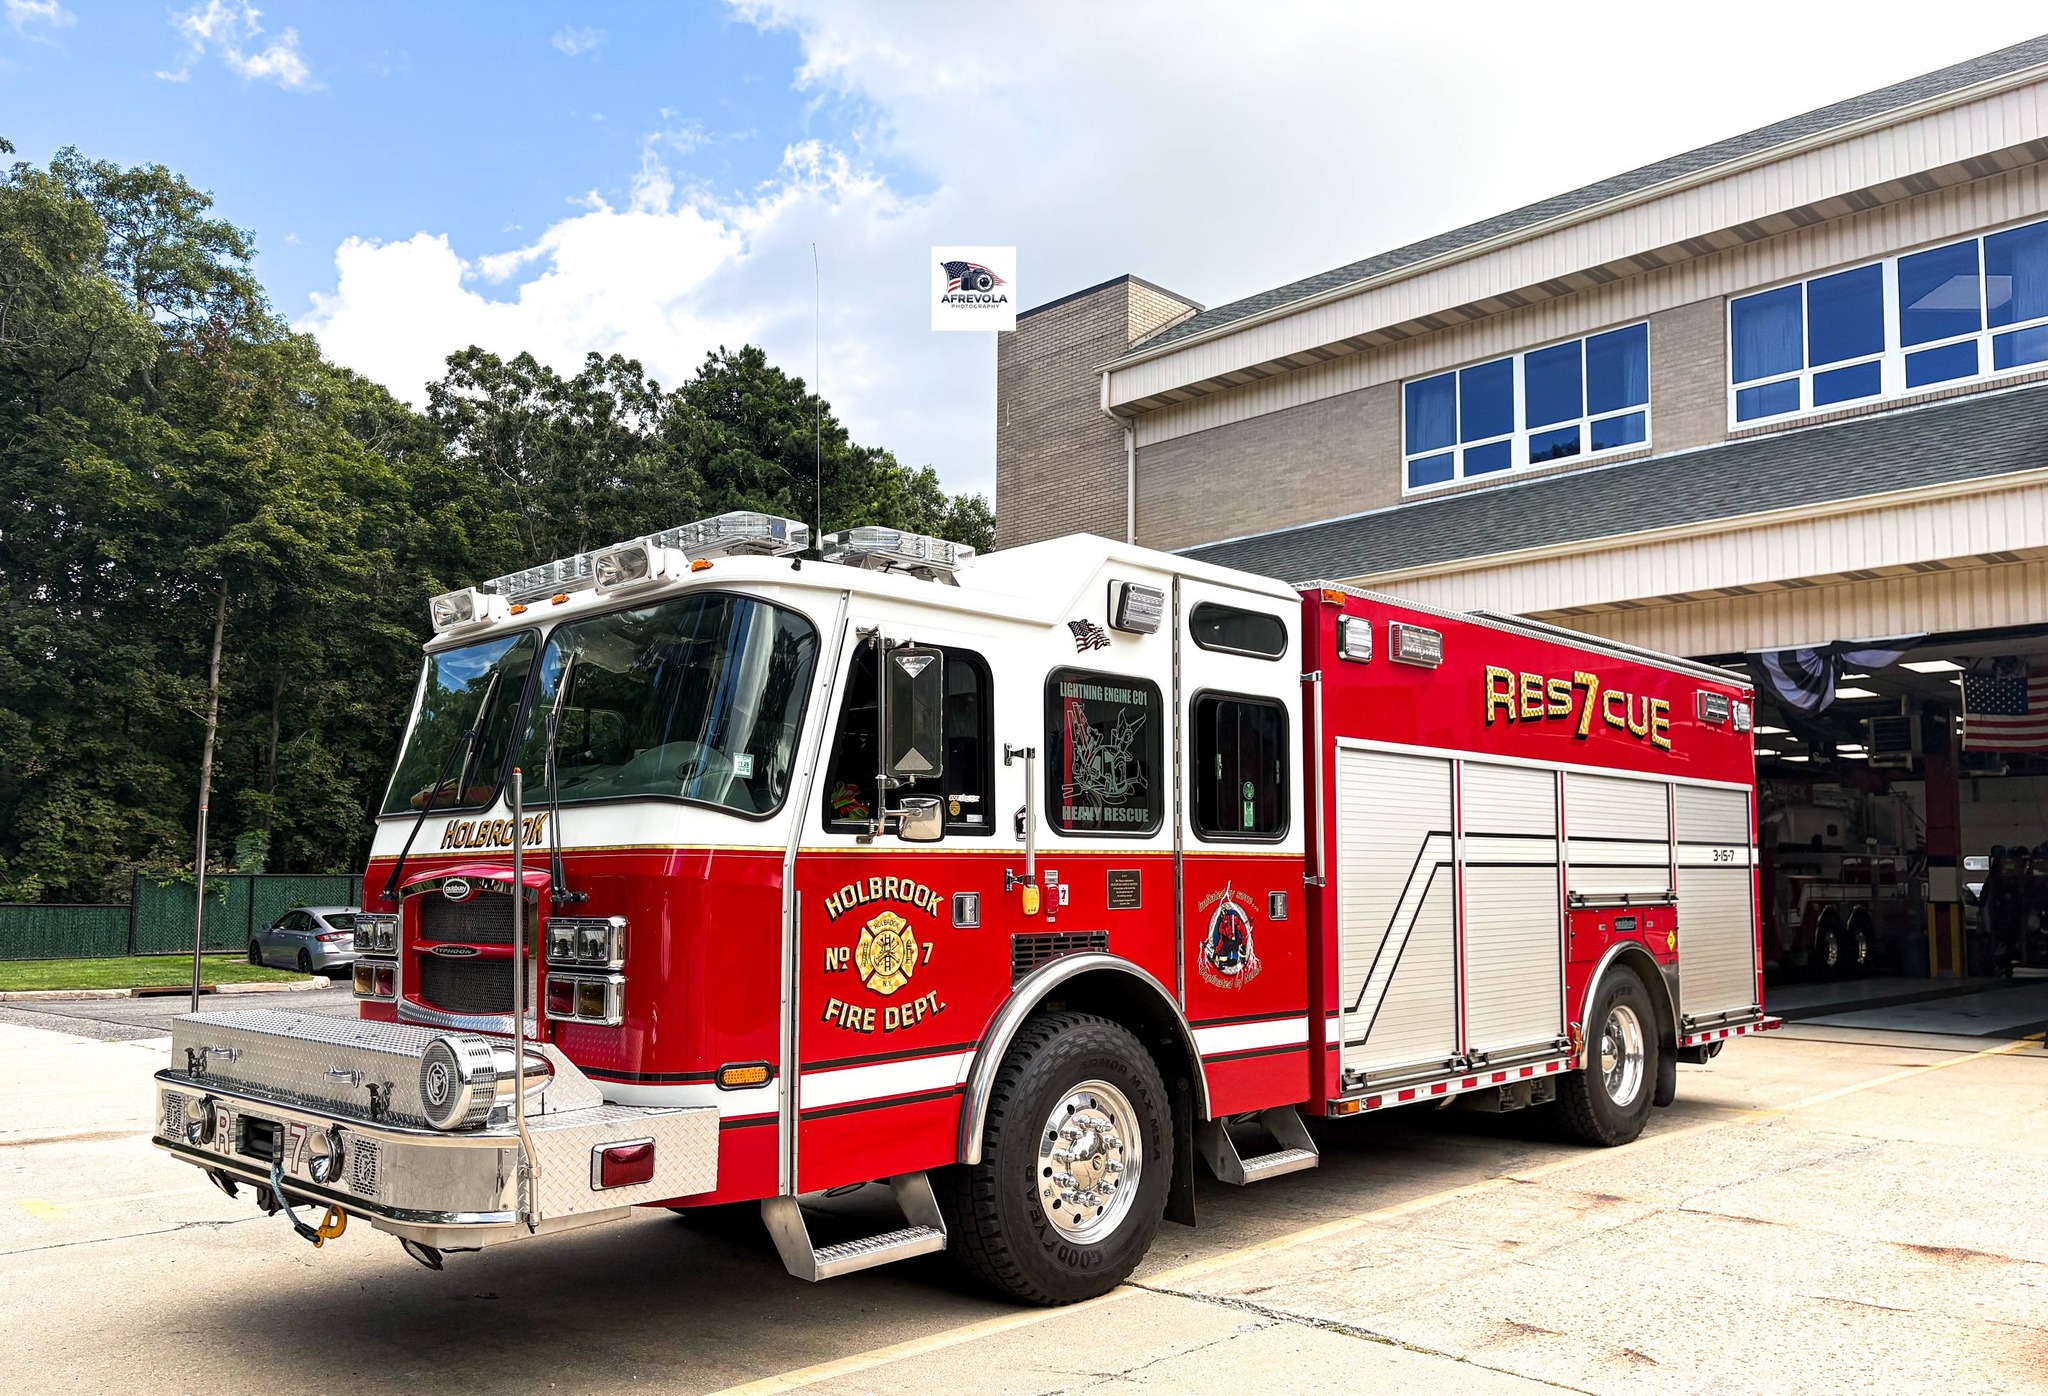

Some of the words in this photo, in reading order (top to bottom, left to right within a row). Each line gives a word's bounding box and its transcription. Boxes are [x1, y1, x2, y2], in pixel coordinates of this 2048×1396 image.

[1060, 681, 1103, 701] LIGHTNING
[1104, 686, 1132, 704] ENGINE
[440, 813, 549, 850] HOLBROOK
[1062, 805, 1101, 823] HEAVY
[1103, 807, 1149, 823] RESCUE
[824, 876, 945, 924] HOLBROOK
[873, 918, 901, 929] HOLBROOK
[920, 942, 934, 968] 7
[821, 997, 877, 1035] FIRE
[883, 990, 947, 1034] DEPT.
[1129, 1074, 1154, 1112] MAX
[215, 1105, 231, 1155] R
[290, 1122, 308, 1174] 7
